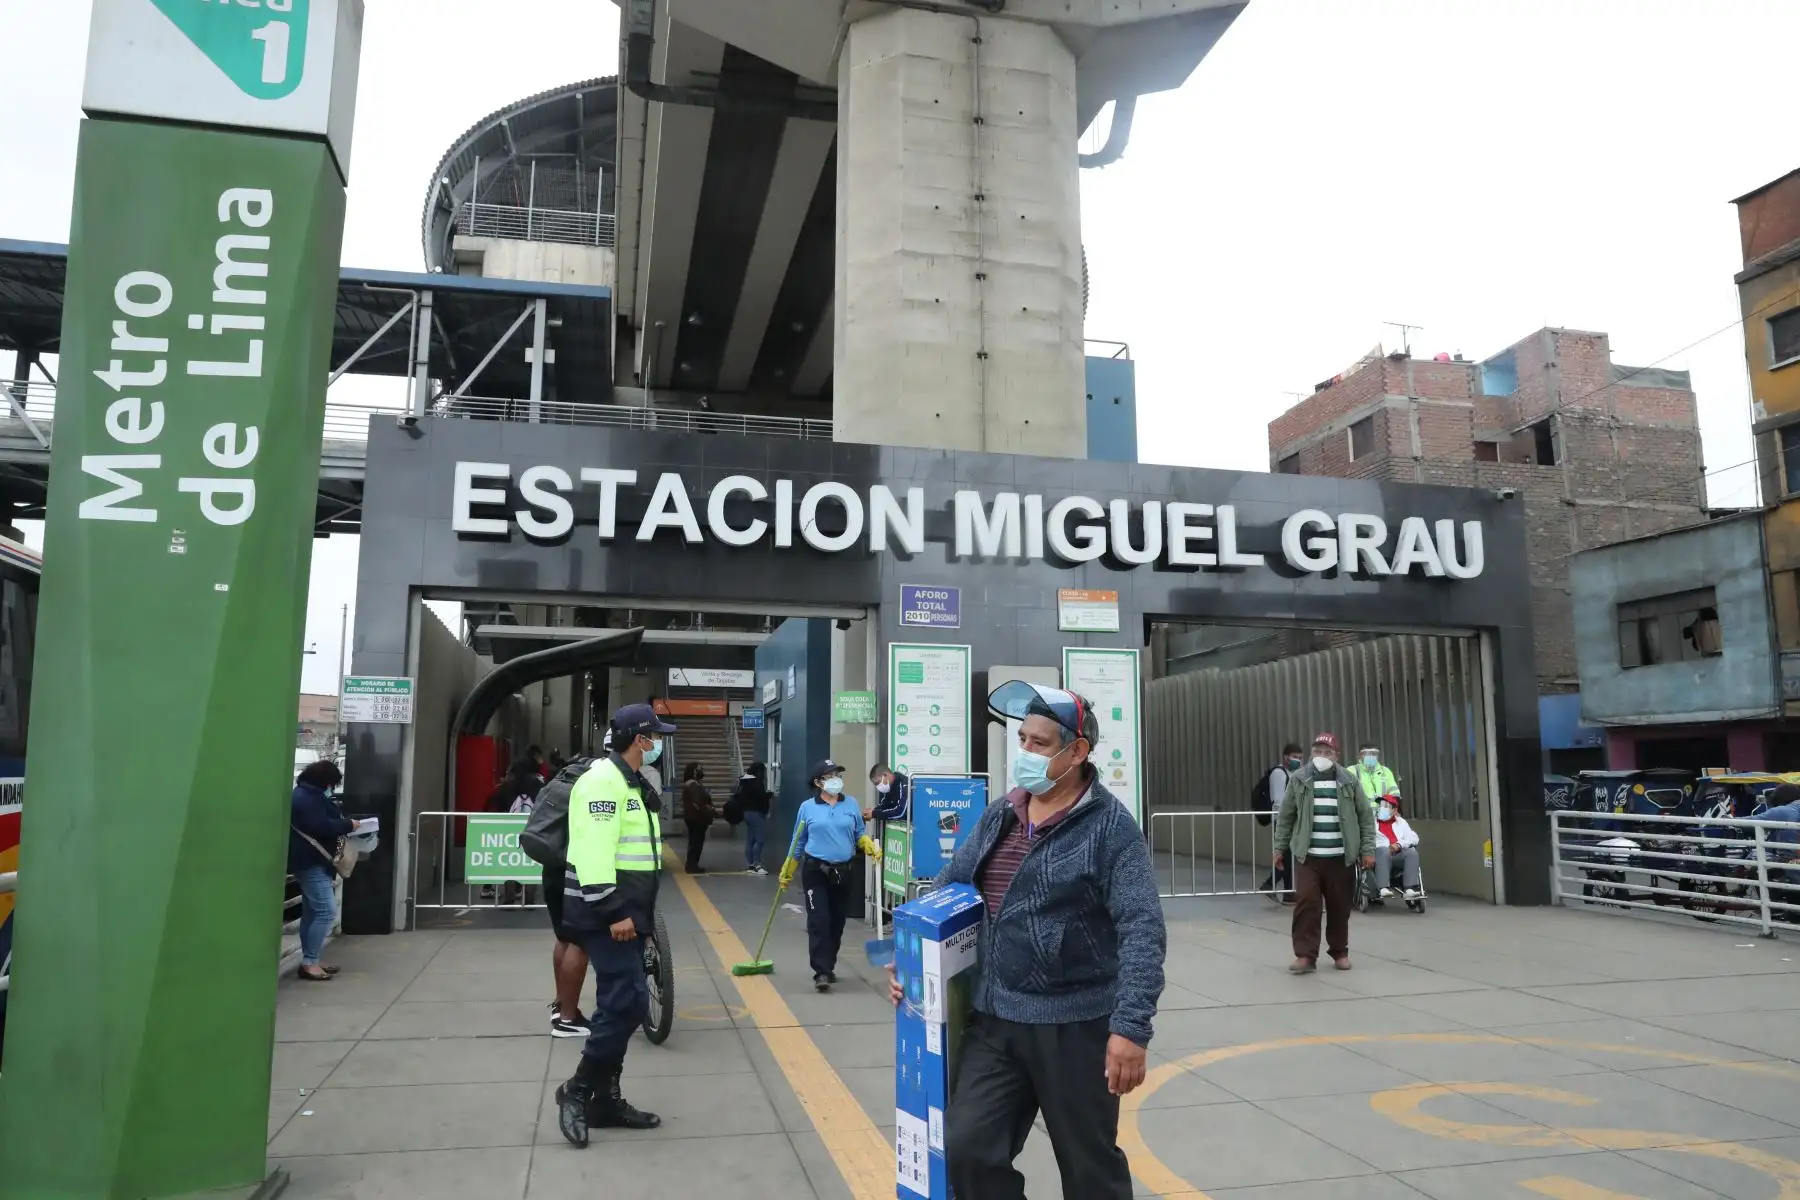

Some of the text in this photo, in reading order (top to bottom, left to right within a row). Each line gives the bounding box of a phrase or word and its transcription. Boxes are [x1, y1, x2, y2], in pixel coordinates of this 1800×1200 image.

[251, 20, 290, 84] 1
[178, 187, 273, 526] de Lima
[79, 270, 173, 522] Metro
[452, 461, 1485, 580] ESTACION MIGUEL GRAU
[914, 590, 949, 600] AFORO
[916, 601, 947, 611] TOTAL
[906, 611, 957, 622] 2010 PERSONAS
[590, 801, 616, 813] GSGC
[929, 800, 949, 808] MIDE
[480, 832, 522, 848] INICI
[471, 851, 493, 866] DE
[945, 932, 965, 949] MULTI
